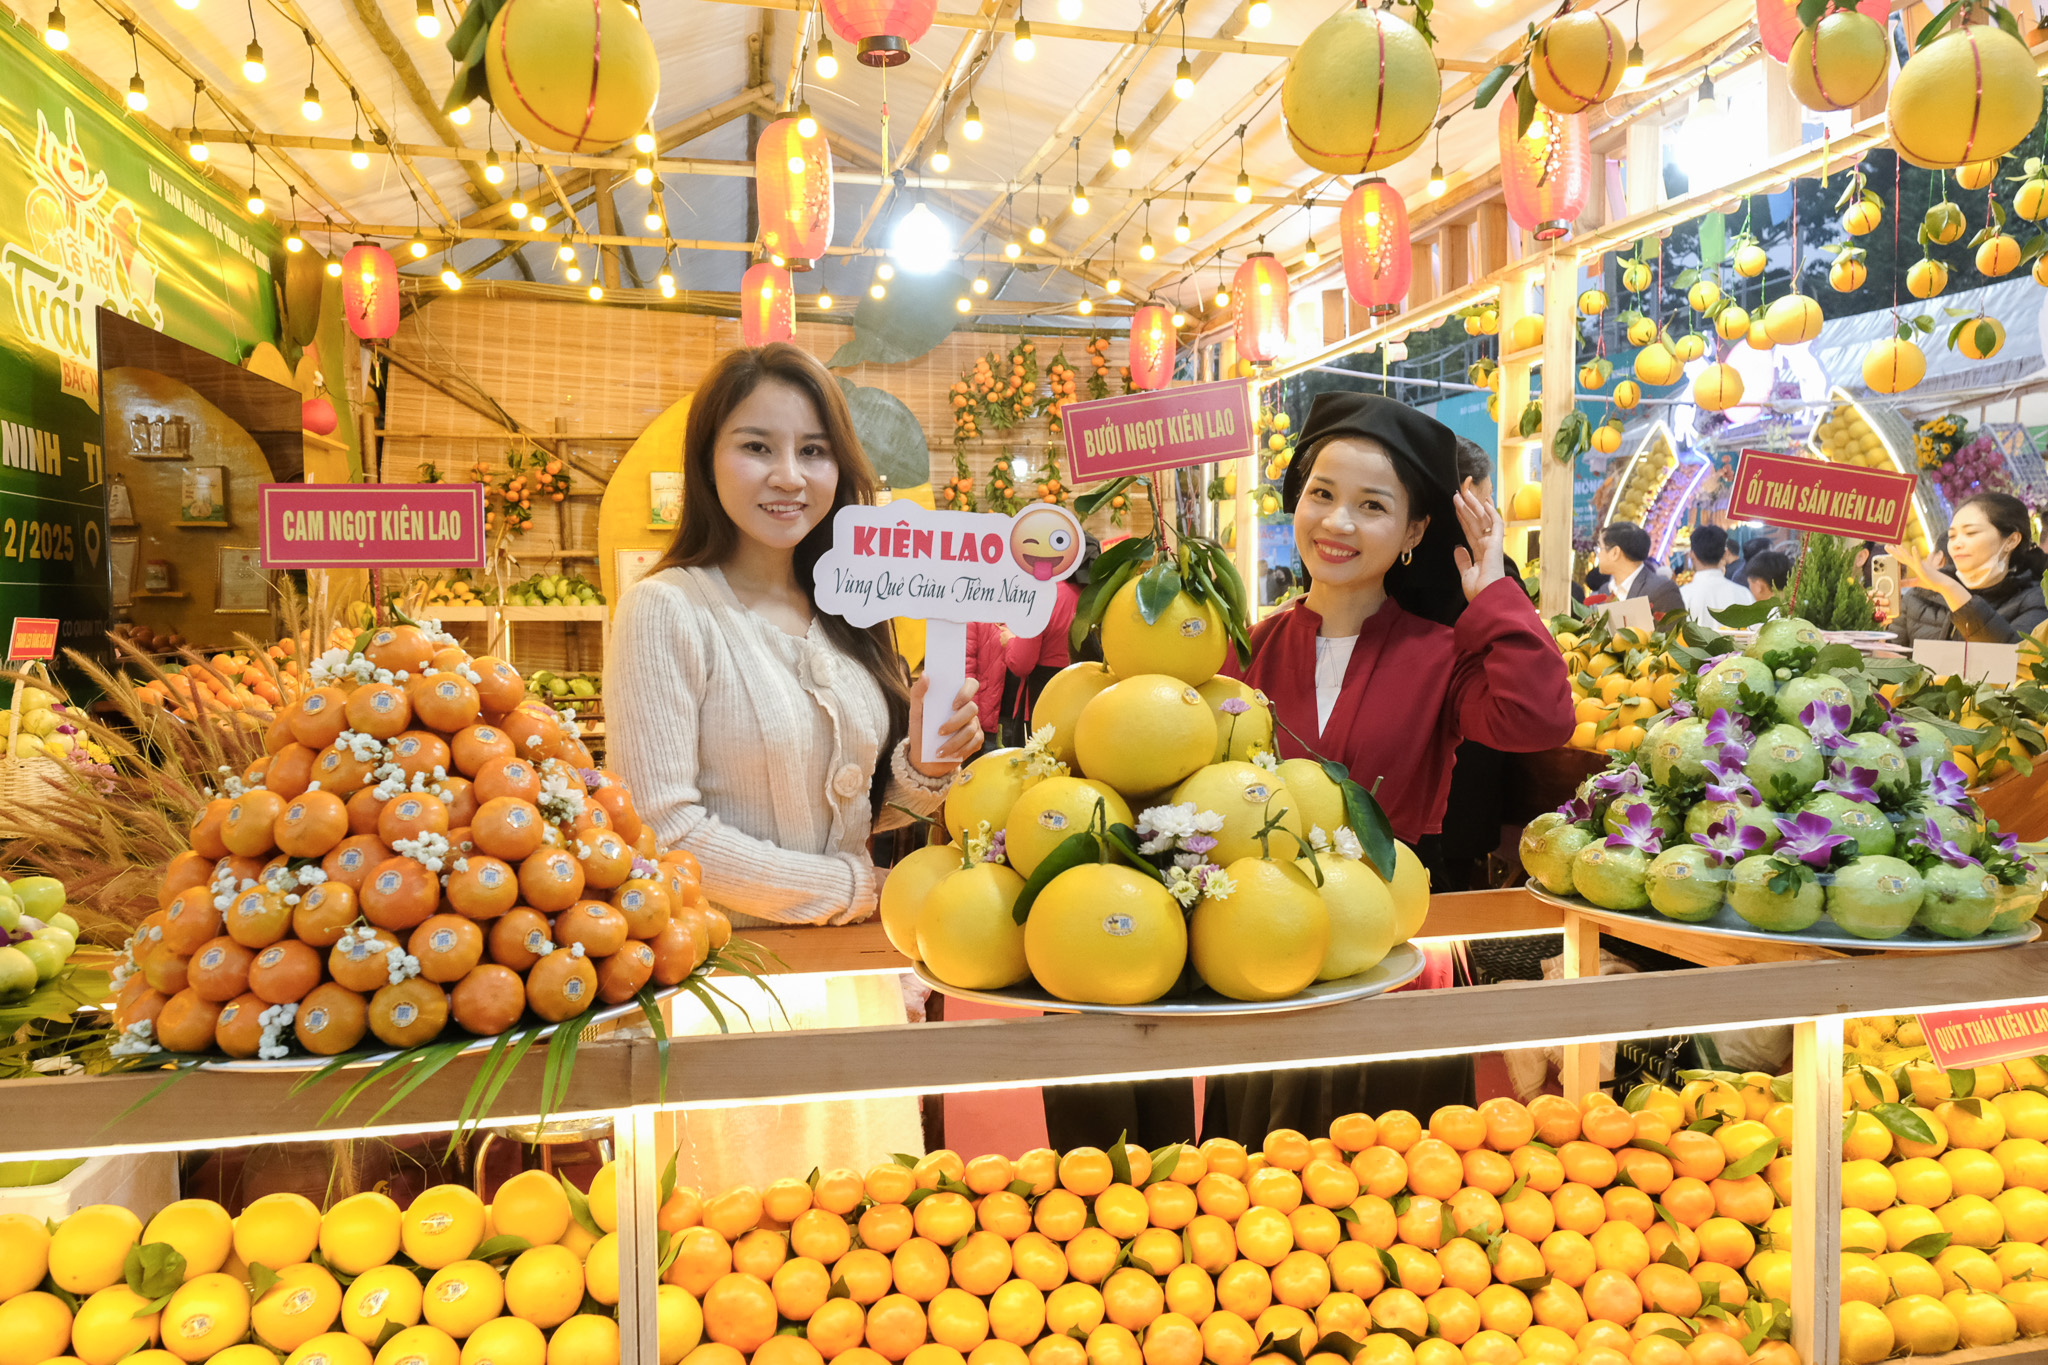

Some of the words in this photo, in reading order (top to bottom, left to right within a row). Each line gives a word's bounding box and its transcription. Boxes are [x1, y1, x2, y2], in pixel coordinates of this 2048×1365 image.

[5, 250, 90, 360] Trái
[1, 419, 62, 477] NINH
[1083, 416, 1122, 458] BƯỞI
[1124, 418, 1165, 455] NGỌT
[1167, 408, 1205, 445] KIÊN
[1206, 407, 1236, 439] LAO
[1745, 469, 1764, 505] ỔI
[1764, 479, 1798, 511] THÁI
[1829, 488, 1864, 521] KIÊN
[1866, 496, 1896, 526] LAO
[4, 518, 74, 562] 2/2025
[282, 510, 324, 542] CAM
[328, 510, 377, 548] NGỌT
[381, 504, 424, 541] KIÊN
[428, 510, 461, 541] LAO
[853, 519, 934, 560] KIÊN
[940, 531, 1004, 565] LAO
[833, 567, 873, 607] Vùng
[875, 570, 904, 600] Quê
[908, 573, 946, 599] Giàu
[997, 574, 1037, 617] Năng
[1934, 1020, 1969, 1054] QUÝT
[1964, 1014, 2000, 1046] THÁI
[1993, 1009, 2031, 1041] KIÊN
